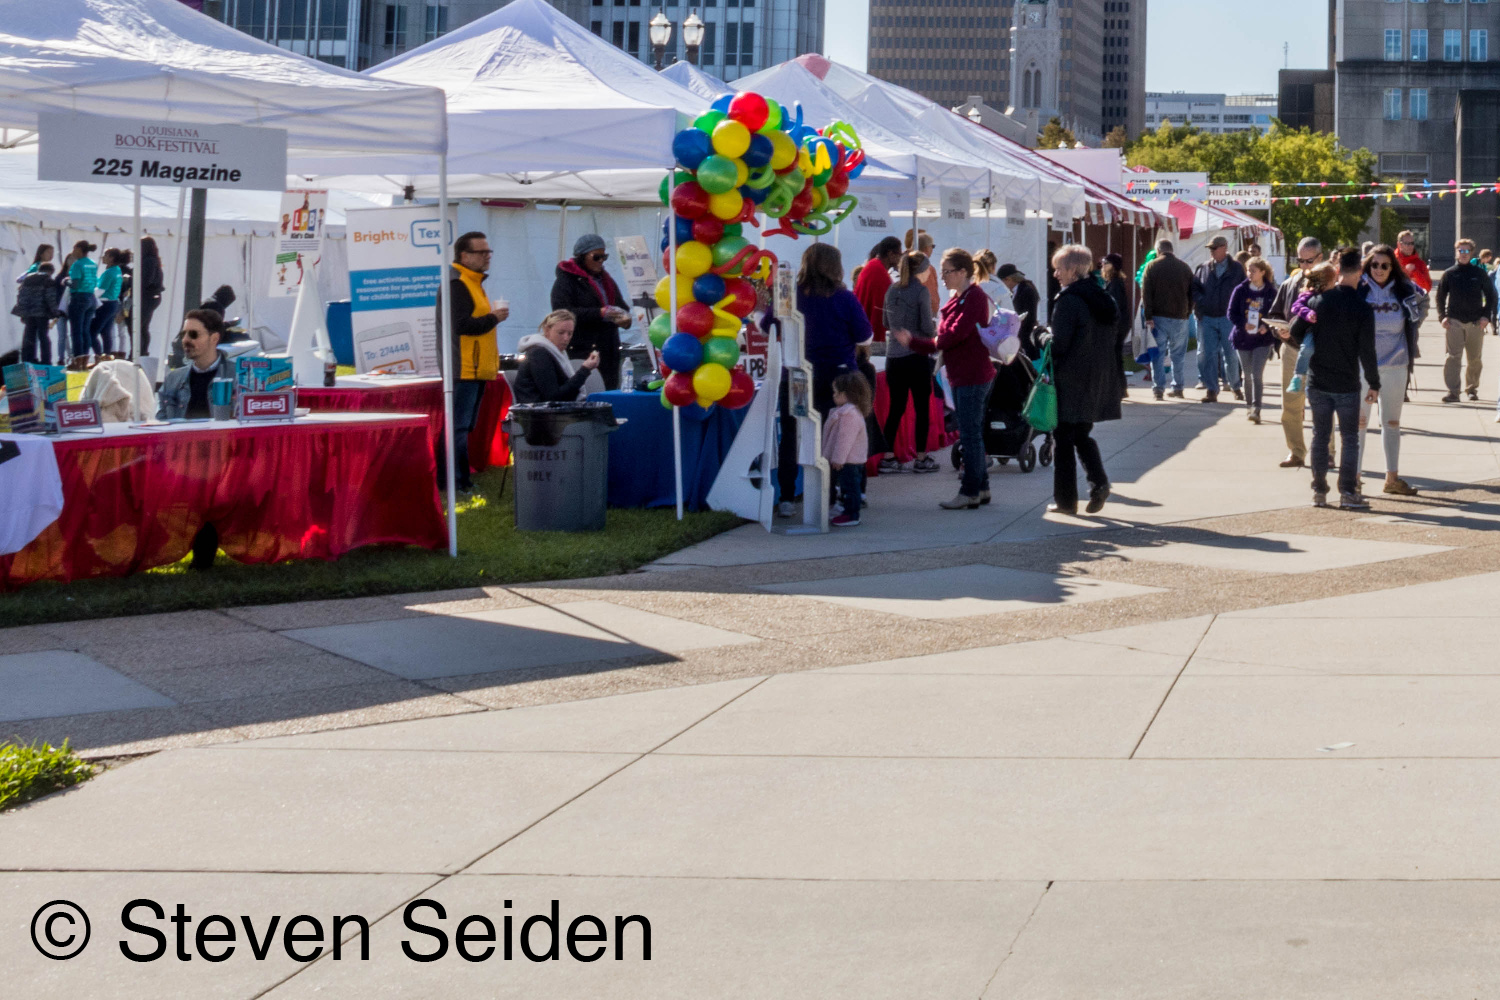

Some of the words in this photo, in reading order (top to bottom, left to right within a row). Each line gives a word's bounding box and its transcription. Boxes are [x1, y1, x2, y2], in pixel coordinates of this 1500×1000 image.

[141, 125, 199, 138] LOUISIANA
[91, 158, 133, 177] 225
[140, 160, 242, 183] Magazine
[1208, 189, 1260, 197] HILDREN'S
[293, 210, 317, 230] LPB
[353, 230, 395, 244] Bright
[397, 232, 408, 242] by
[418, 227, 440, 239] Tex
